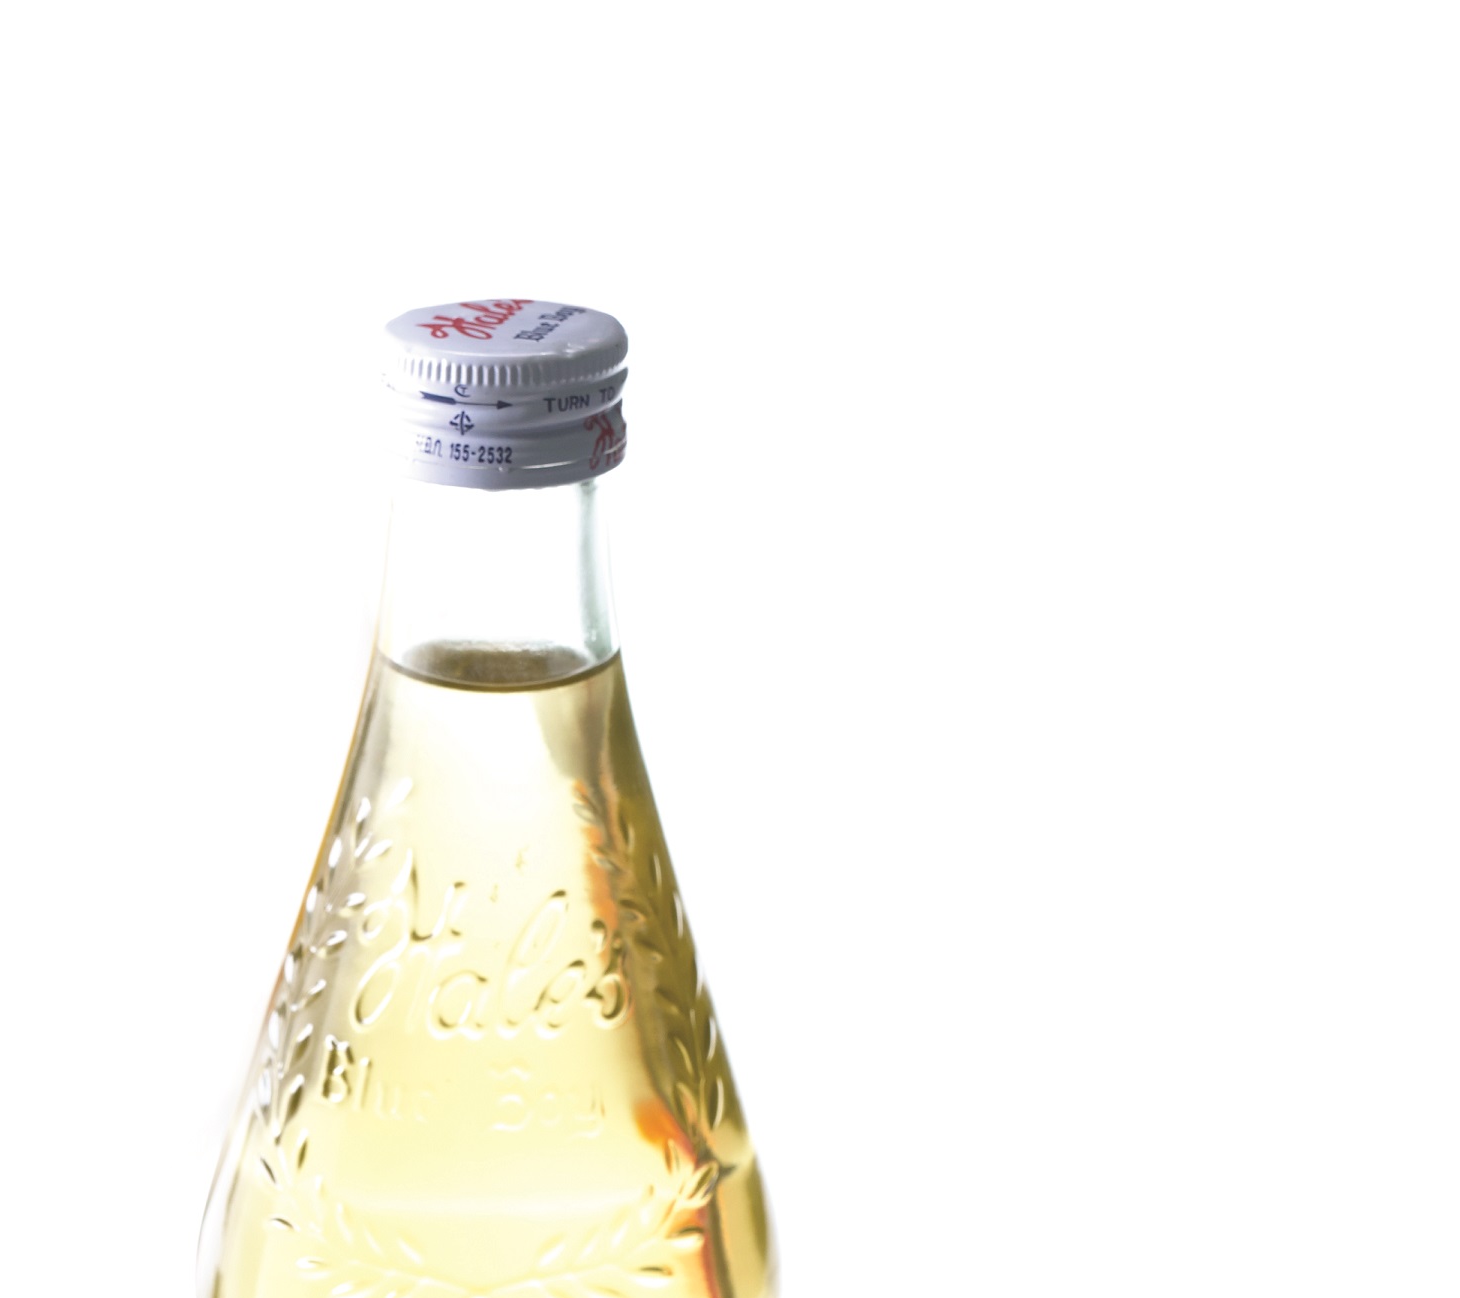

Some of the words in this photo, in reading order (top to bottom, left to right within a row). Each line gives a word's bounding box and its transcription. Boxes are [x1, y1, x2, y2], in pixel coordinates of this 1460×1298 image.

[543, 394, 590, 413] TURN
[599, 386, 616, 402] TO
[450, 443, 513, 464] 155-2532
